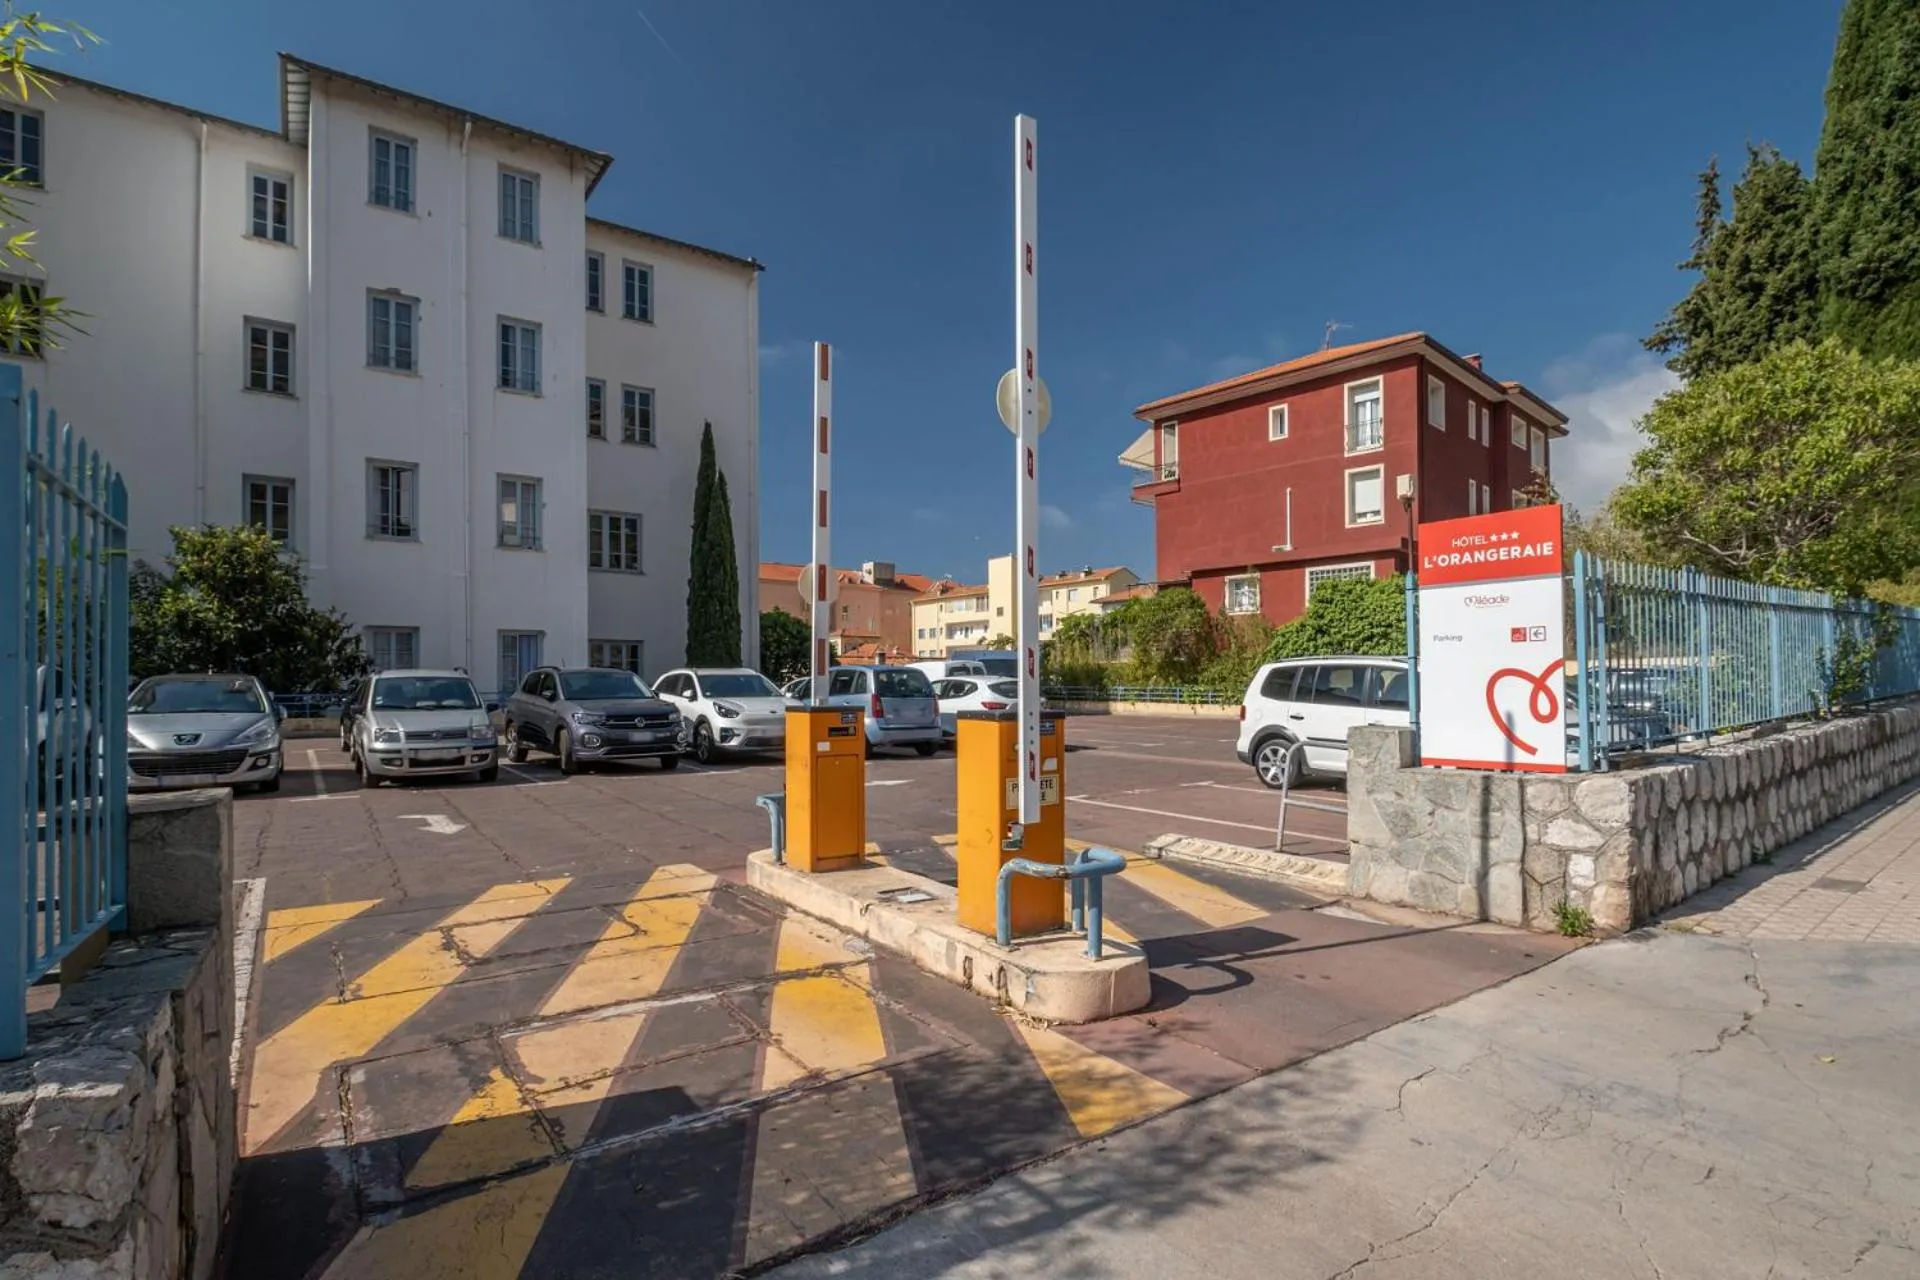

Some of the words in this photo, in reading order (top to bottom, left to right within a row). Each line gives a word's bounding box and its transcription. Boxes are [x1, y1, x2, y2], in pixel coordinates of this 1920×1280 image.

[1452, 535, 1488, 548] HÔTEL
[1424, 541, 1554, 569] L'ORANGERAIE
[1433, 634, 1463, 643] Parking
